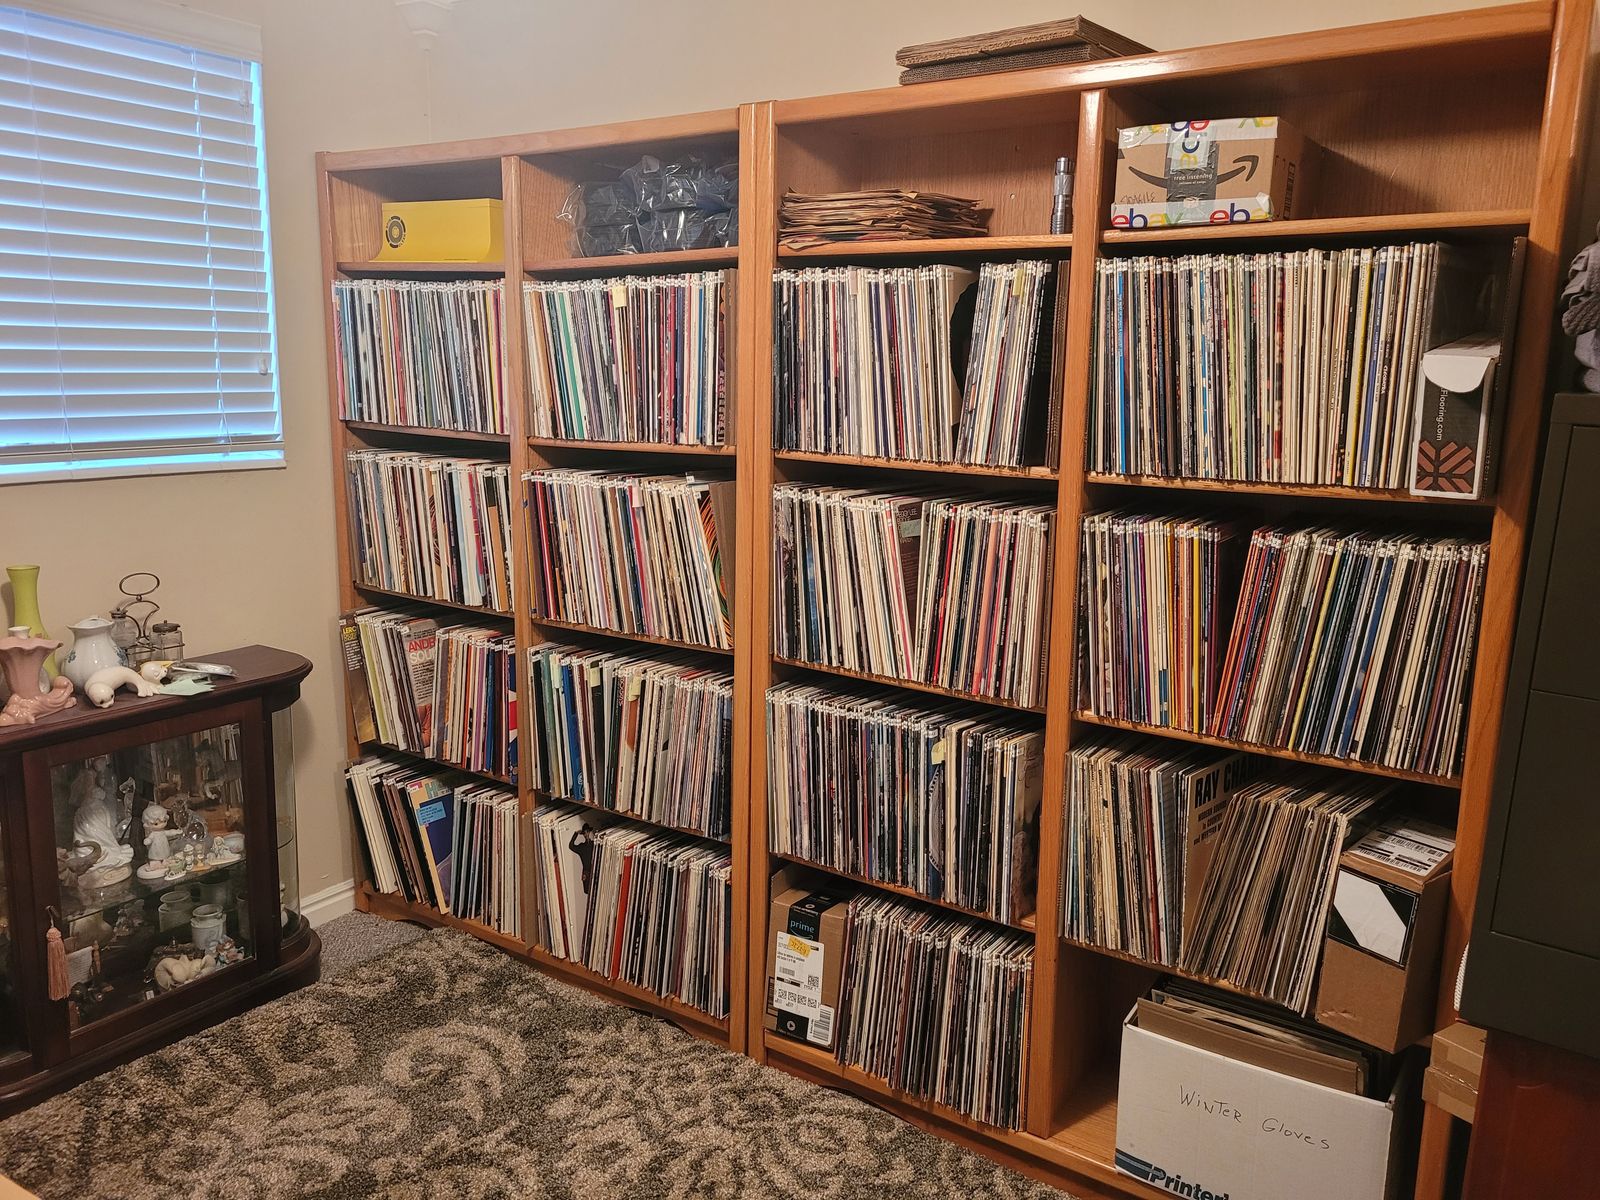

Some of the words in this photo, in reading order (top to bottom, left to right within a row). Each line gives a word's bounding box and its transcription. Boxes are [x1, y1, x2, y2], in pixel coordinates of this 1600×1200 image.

[1436, 387, 1448, 441] Flooring.com
[1195, 769, 1220, 808] RAY
[790, 919, 815, 934] prime
